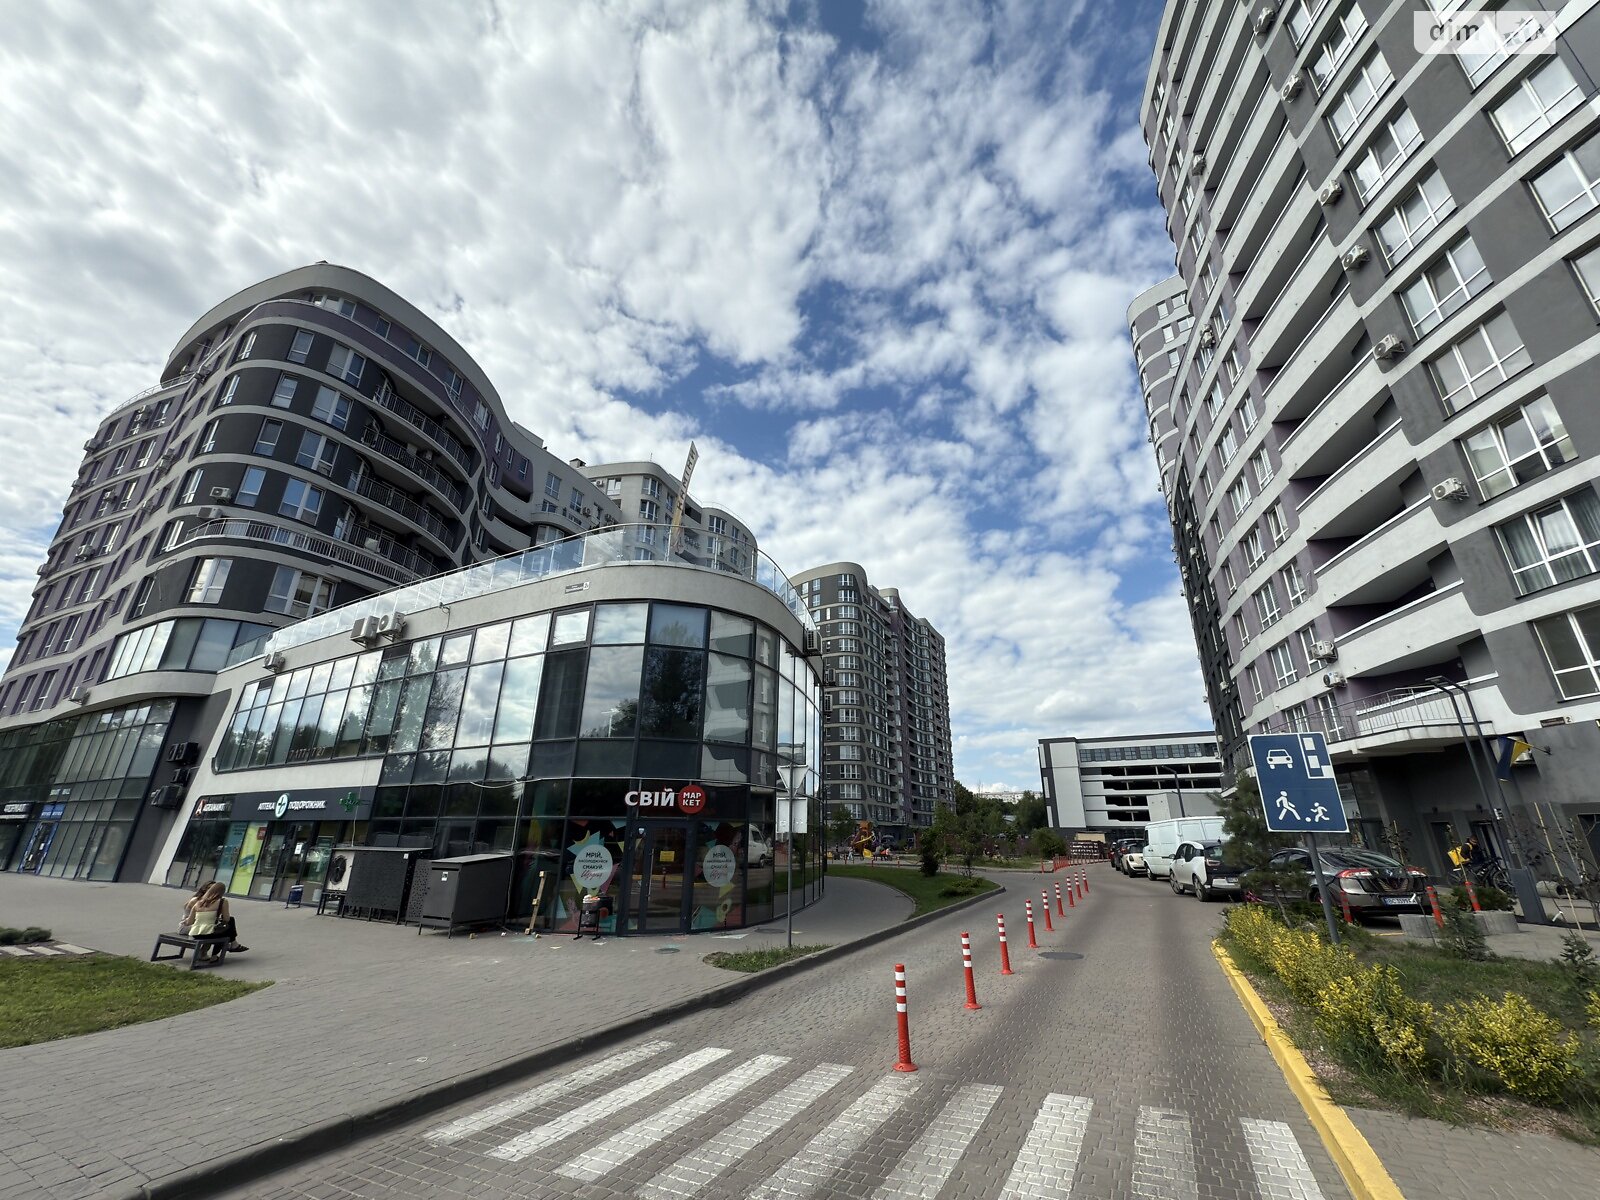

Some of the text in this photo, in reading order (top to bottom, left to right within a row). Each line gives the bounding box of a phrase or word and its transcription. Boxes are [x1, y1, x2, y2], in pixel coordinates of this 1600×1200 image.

[624, 787, 675, 807] СВІЙ
[257, 800, 327, 811] АПТЕКА ПОДОРОЖНИК
